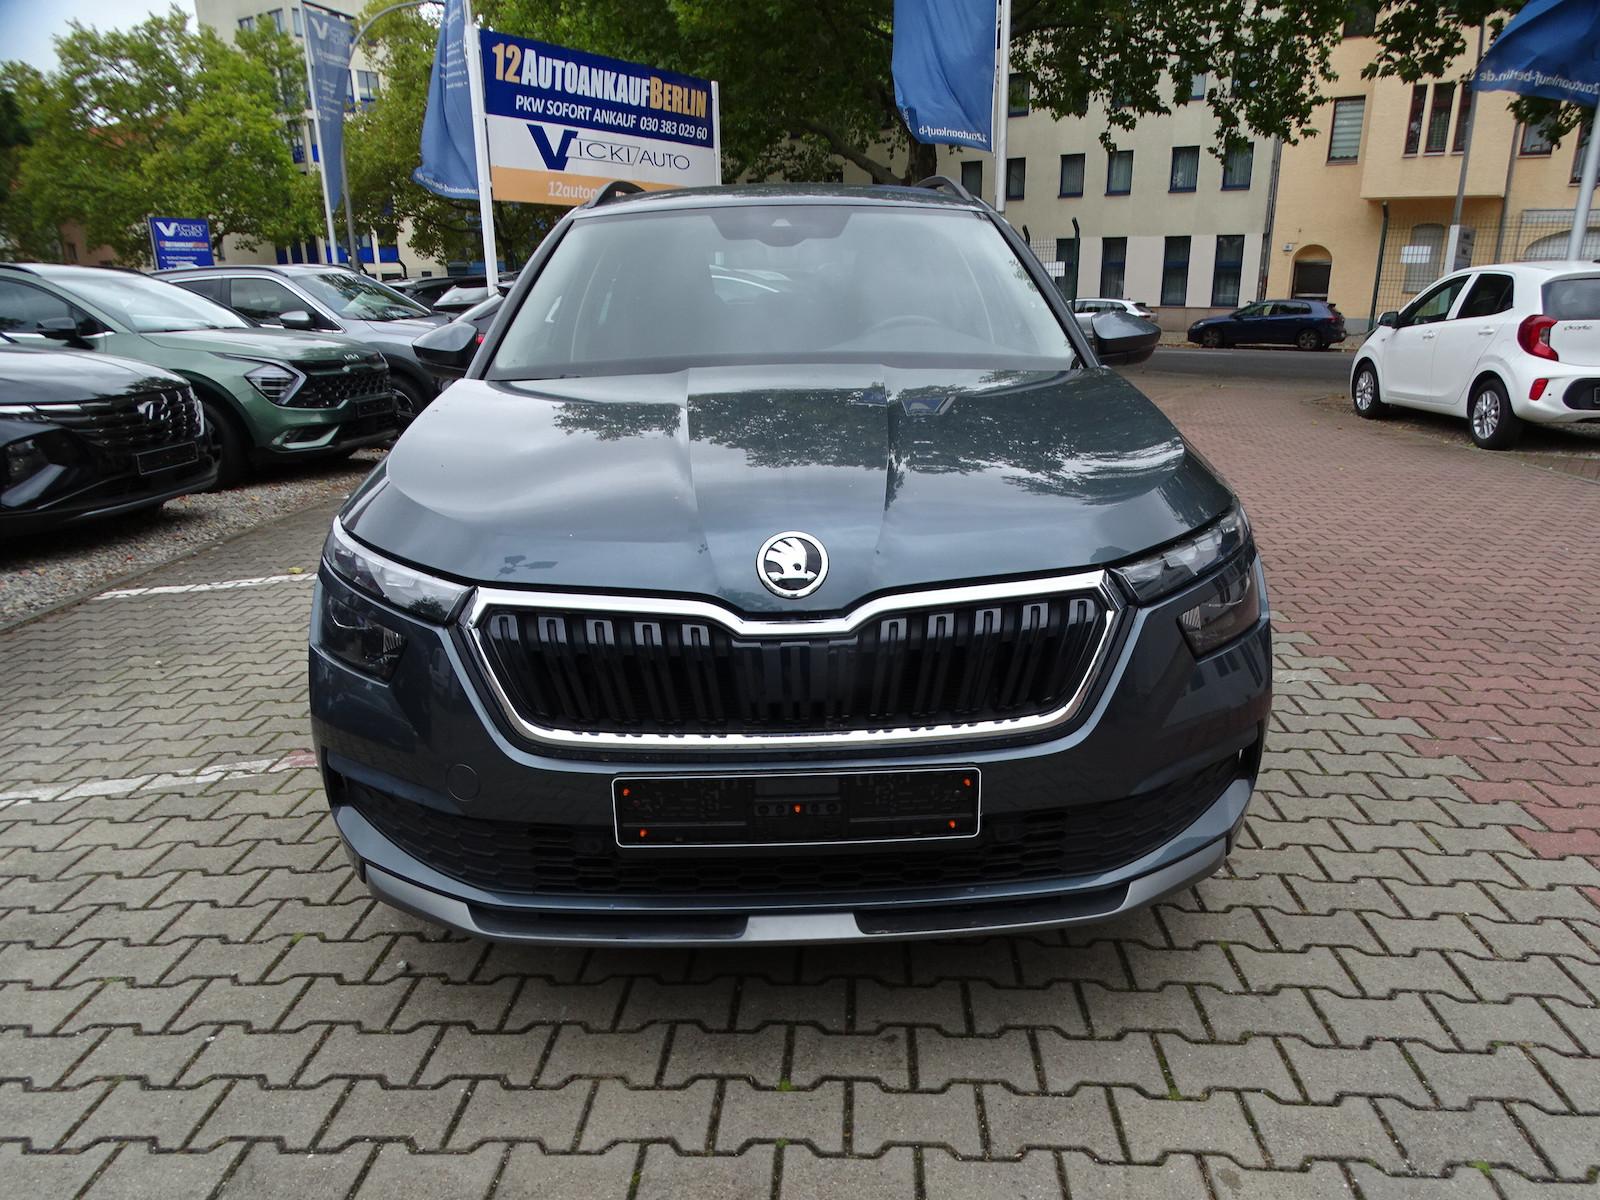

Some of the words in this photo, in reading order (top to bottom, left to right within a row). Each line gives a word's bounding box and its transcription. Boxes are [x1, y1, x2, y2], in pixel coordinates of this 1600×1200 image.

[515, 94, 545, 114] PKW
[546, 100, 592, 121] SOFORT
[593, 108, 637, 128] ANKAUF
[640, 116, 659, 132] 030
[659, 119, 677, 135] 383
[678, 123, 695, 138] 029
[696, 127, 708, 140] 60
[526, 123, 632, 171] VICKI
[639, 150, 691, 170] AUTO
[547, 181, 598, 200] 12autoa
